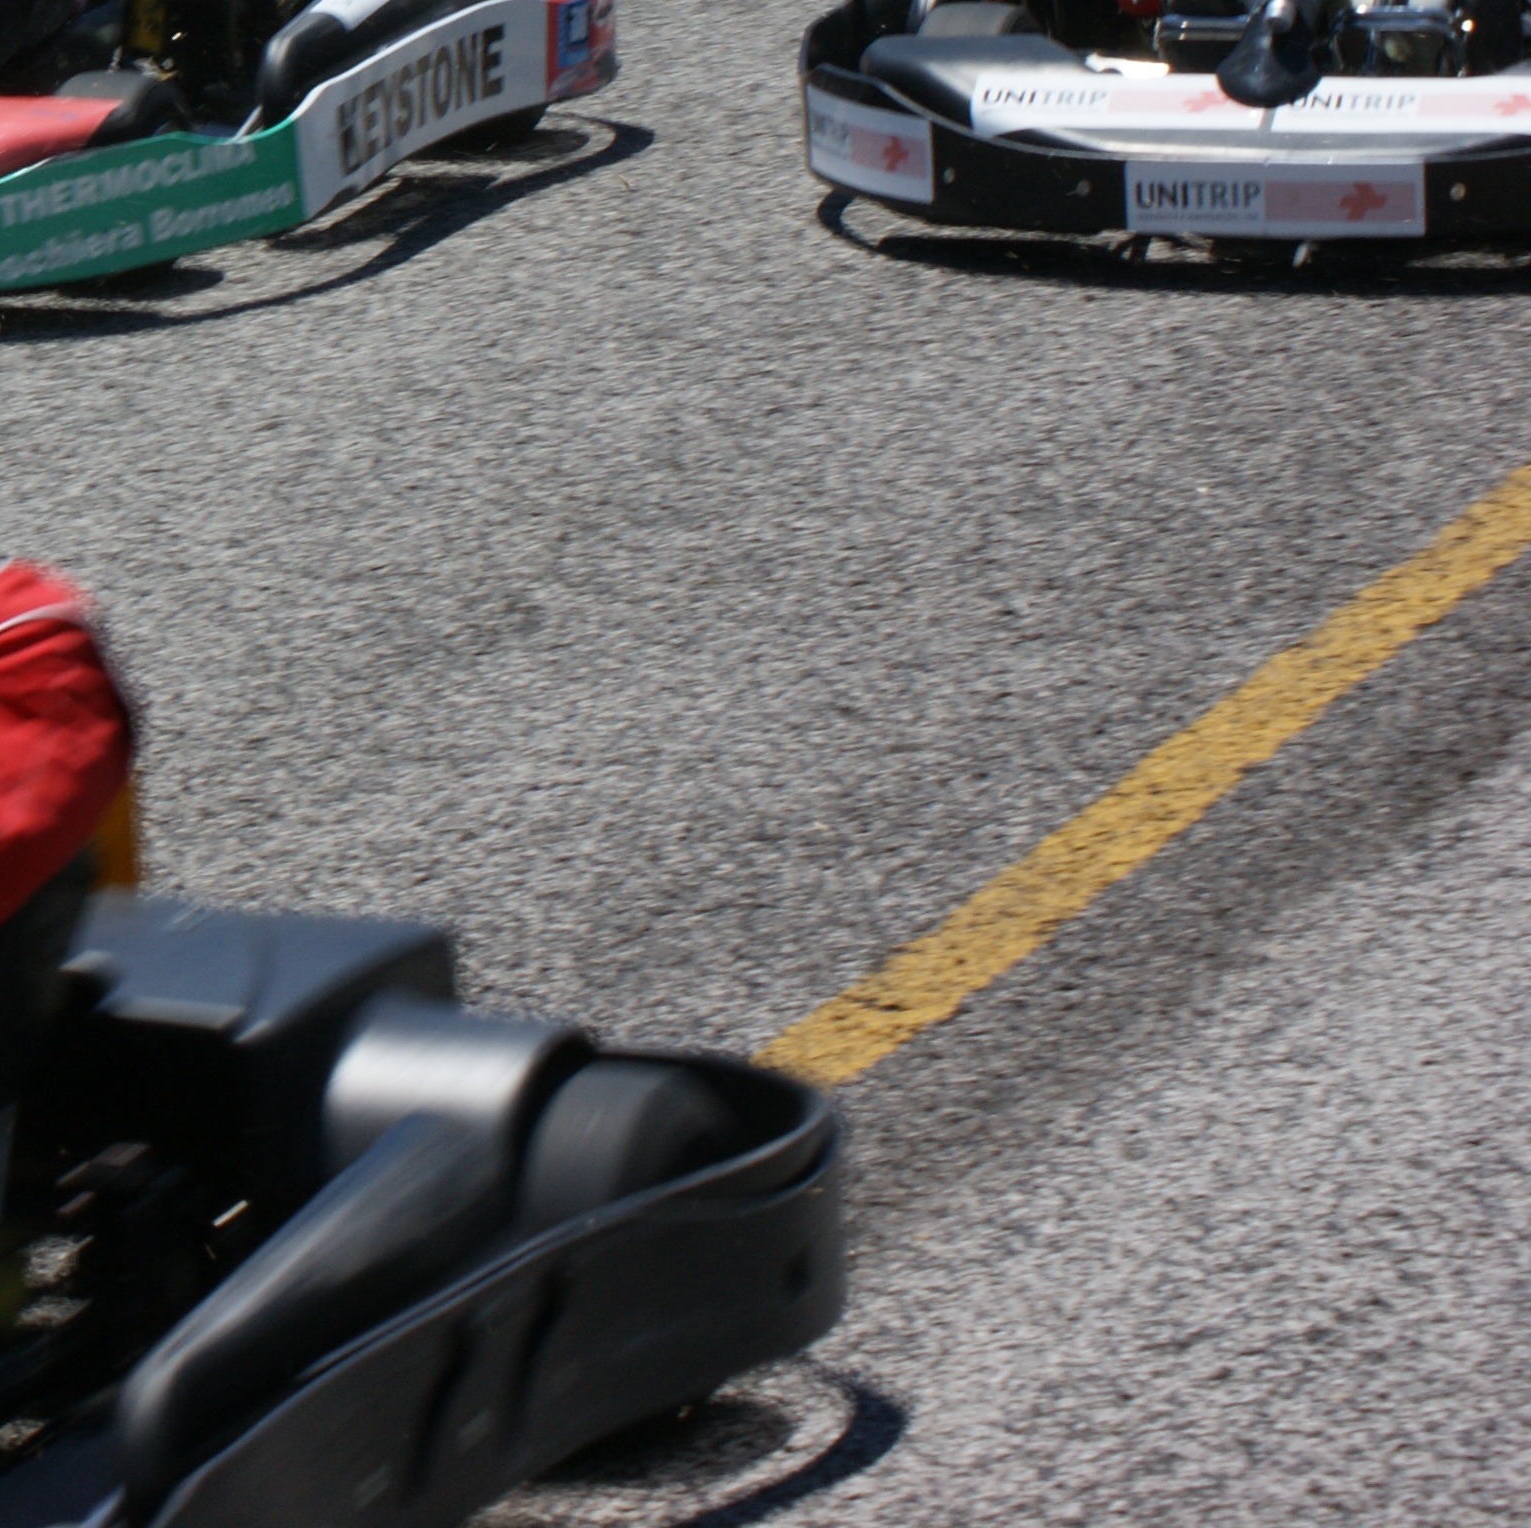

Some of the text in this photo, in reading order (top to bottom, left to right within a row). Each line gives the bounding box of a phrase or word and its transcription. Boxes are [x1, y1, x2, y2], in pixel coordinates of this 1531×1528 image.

[335, 24, 505, 175] KEYSTONE
[983, 89, 1108, 105] UNITRIP
[1135, 181, 1260, 209] UNITRIP
